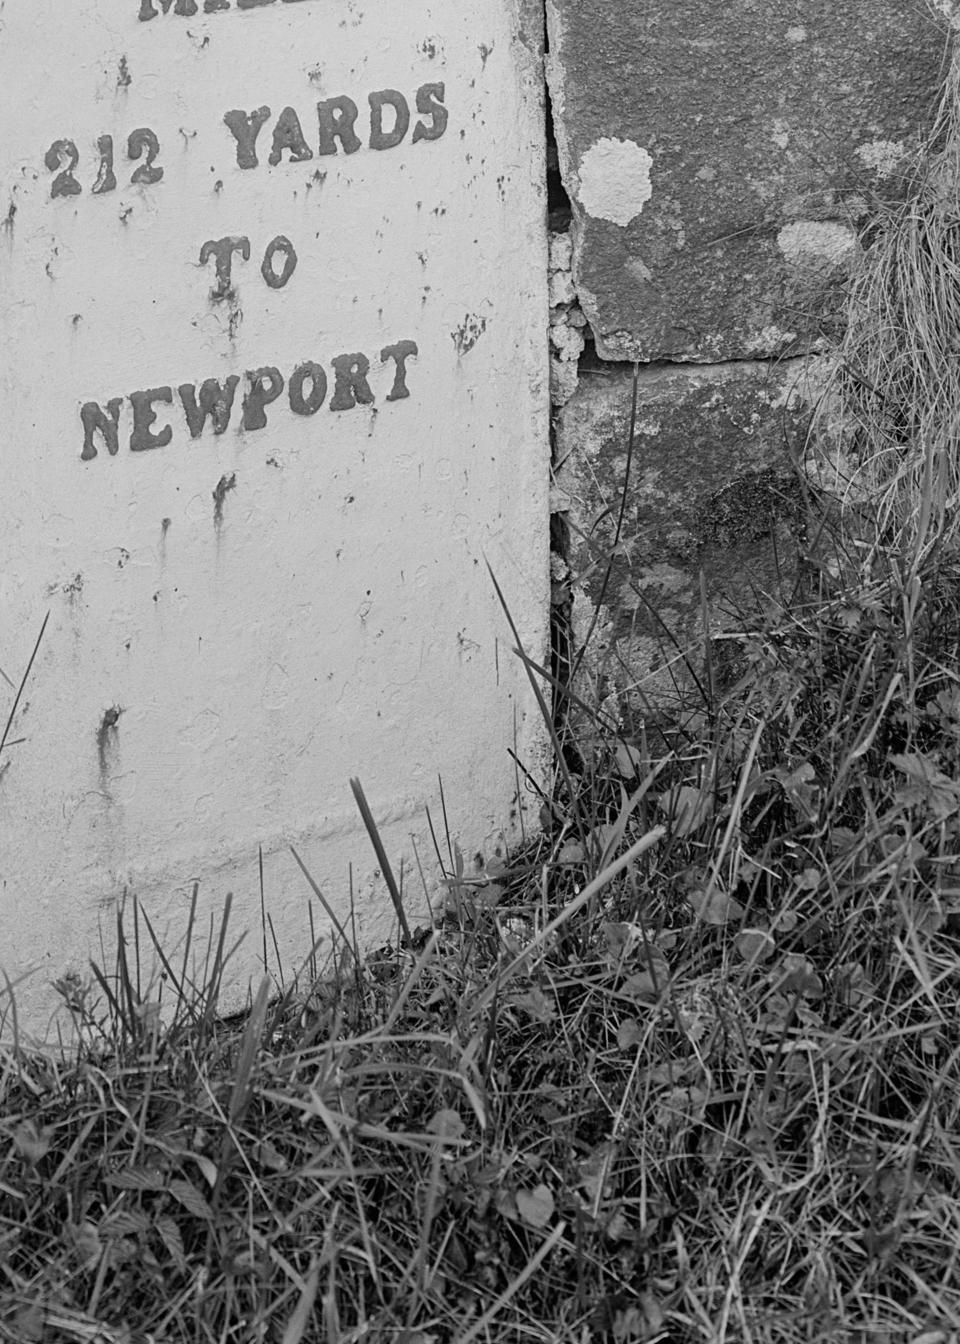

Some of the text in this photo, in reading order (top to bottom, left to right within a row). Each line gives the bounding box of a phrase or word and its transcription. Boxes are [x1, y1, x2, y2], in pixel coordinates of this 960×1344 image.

[44, 82, 449, 199] 212 YARDS
[199, 235, 298, 296] TO
[80, 340, 419, 461] NEWPORT
